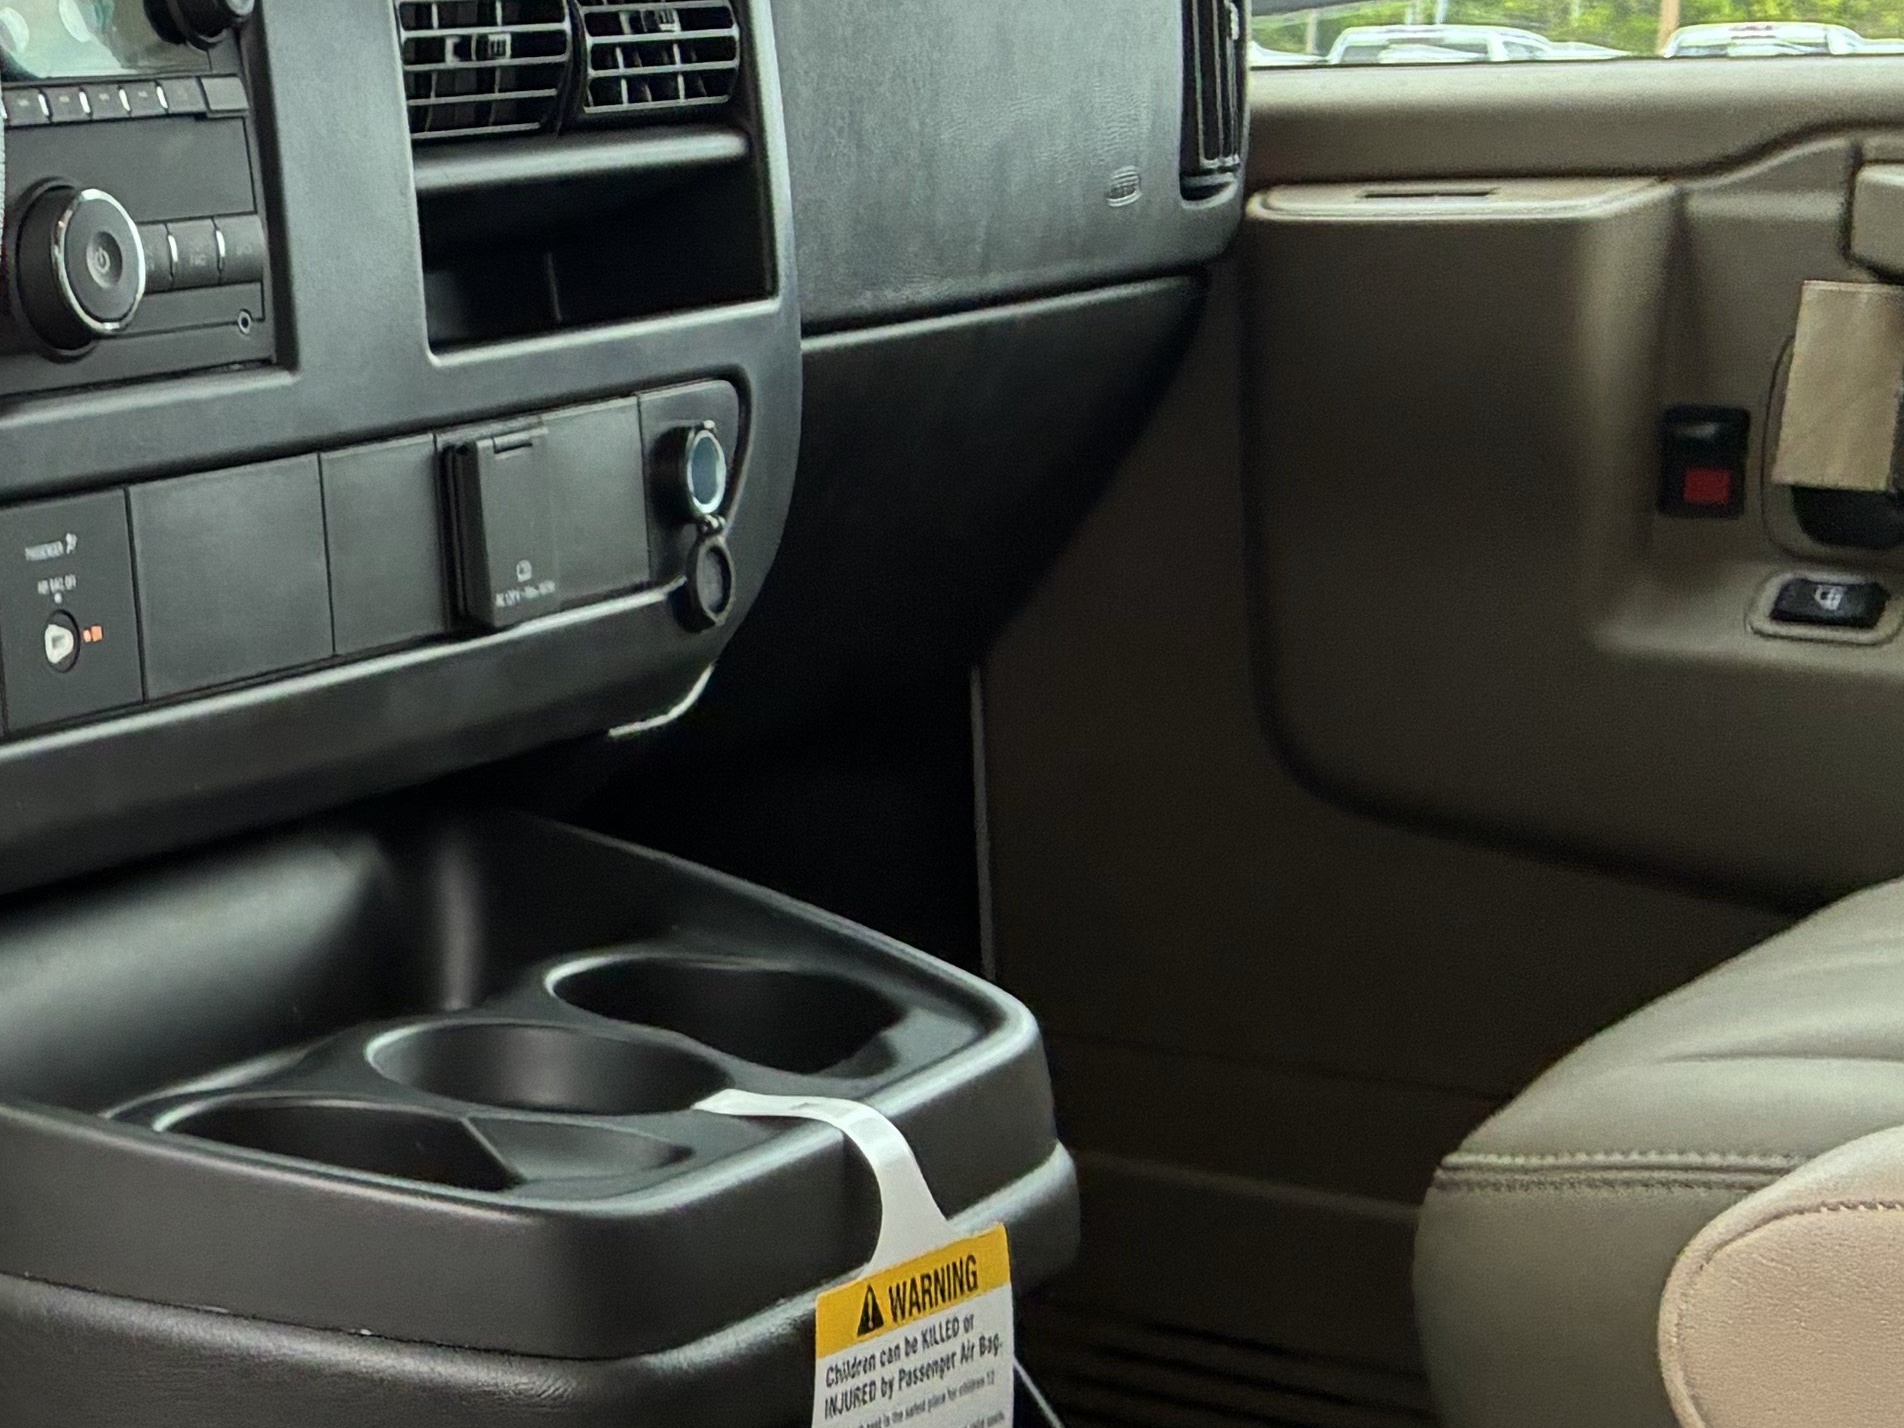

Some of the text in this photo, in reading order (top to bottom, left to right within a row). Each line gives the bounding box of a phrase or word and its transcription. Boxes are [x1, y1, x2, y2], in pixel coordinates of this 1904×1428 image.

[887, 1254, 979, 1323] WARNING
[824, 1381, 877, 1420] INJURED
[880, 1373, 895, 1400] by
[898, 1350, 957, 1391] Passenger
[960, 1340, 975, 1364] Air
[825, 1314, 975, 1388] Children can be KILLED or
